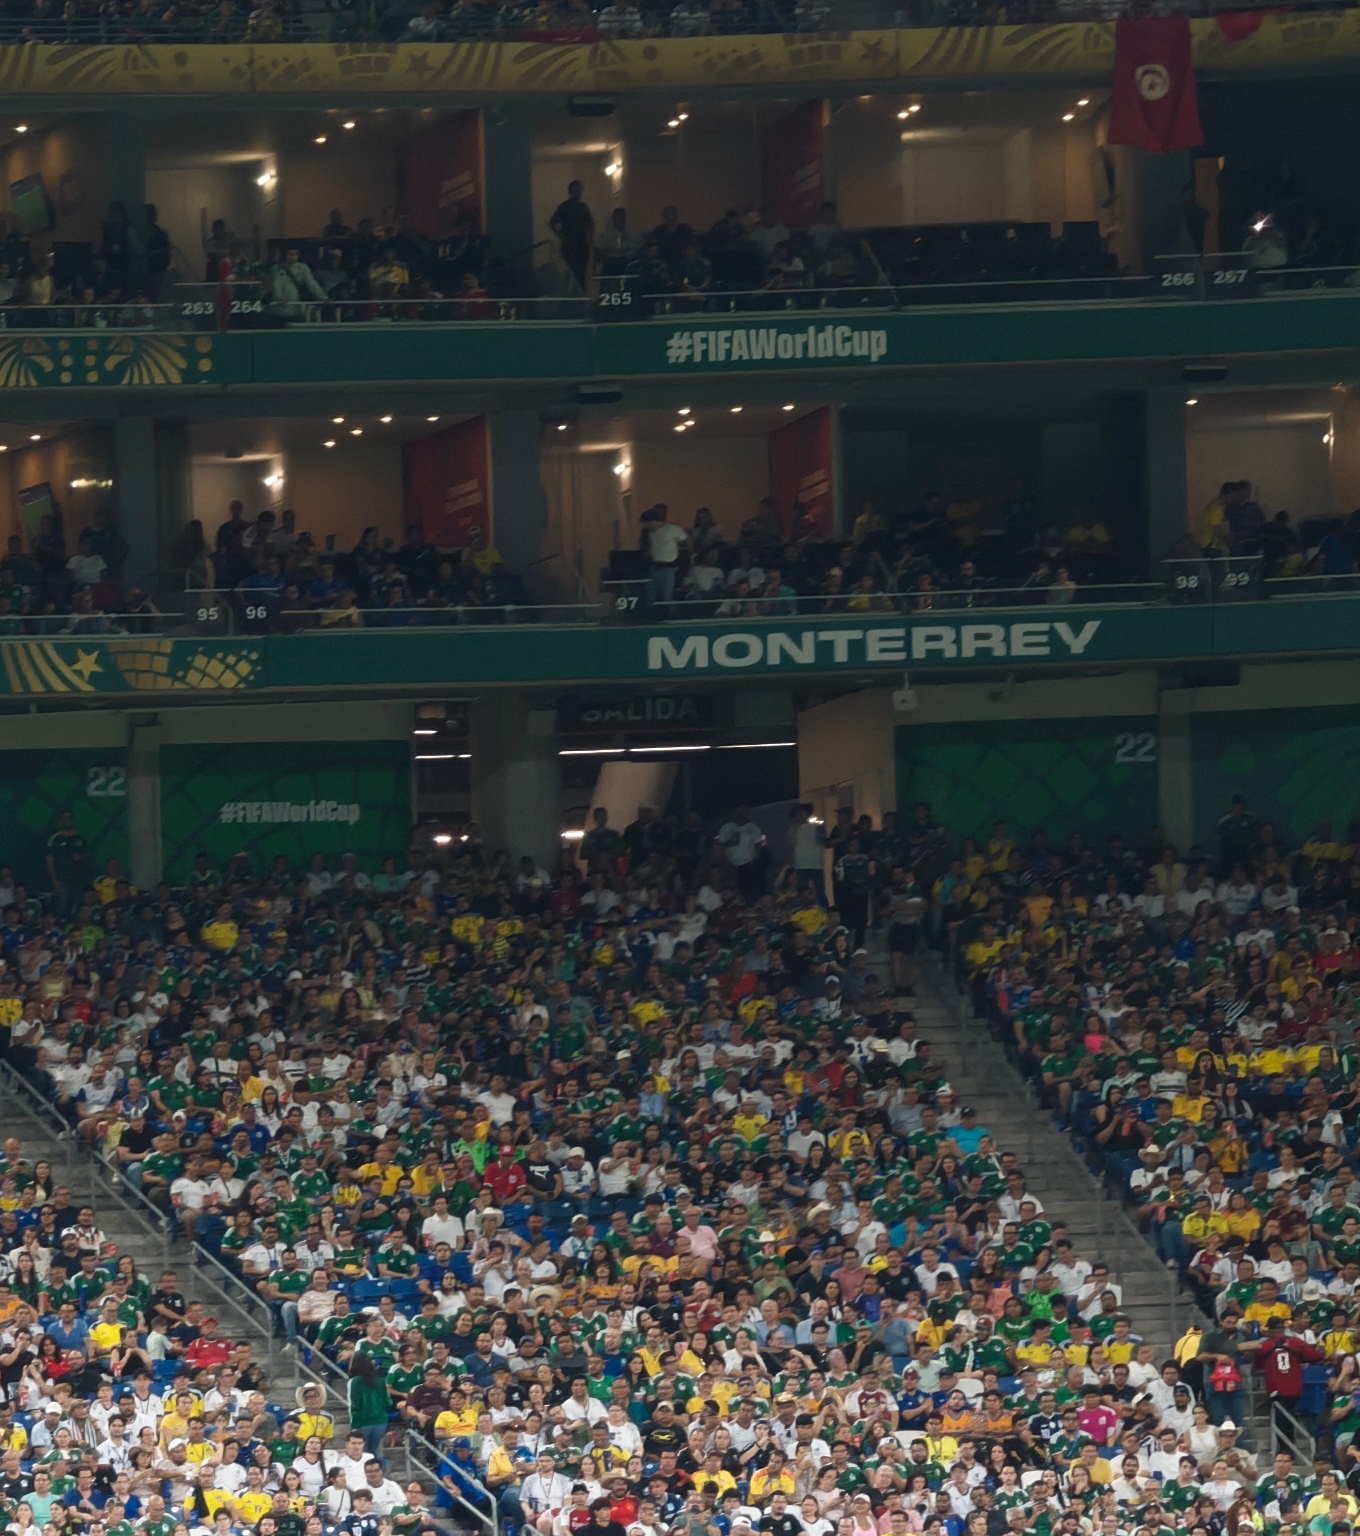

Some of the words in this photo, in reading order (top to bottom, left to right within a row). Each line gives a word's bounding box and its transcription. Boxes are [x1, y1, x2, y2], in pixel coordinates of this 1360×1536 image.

[230, 300, 264, 314] 264
[599, 293, 632, 306] 265
[182, 302, 215, 315] 263
[666, 325, 887, 364] #FIFAWorldCup
[615, 596, 639, 611] 97
[196, 606, 219, 621] 95
[245, 605, 267, 620] 96
[647, 620, 1102, 671] MONTERREY
[1115, 731, 1158, 763] 22
[86, 766, 127, 797] 22
[218, 800, 361, 826] #FIFAWorldCup
